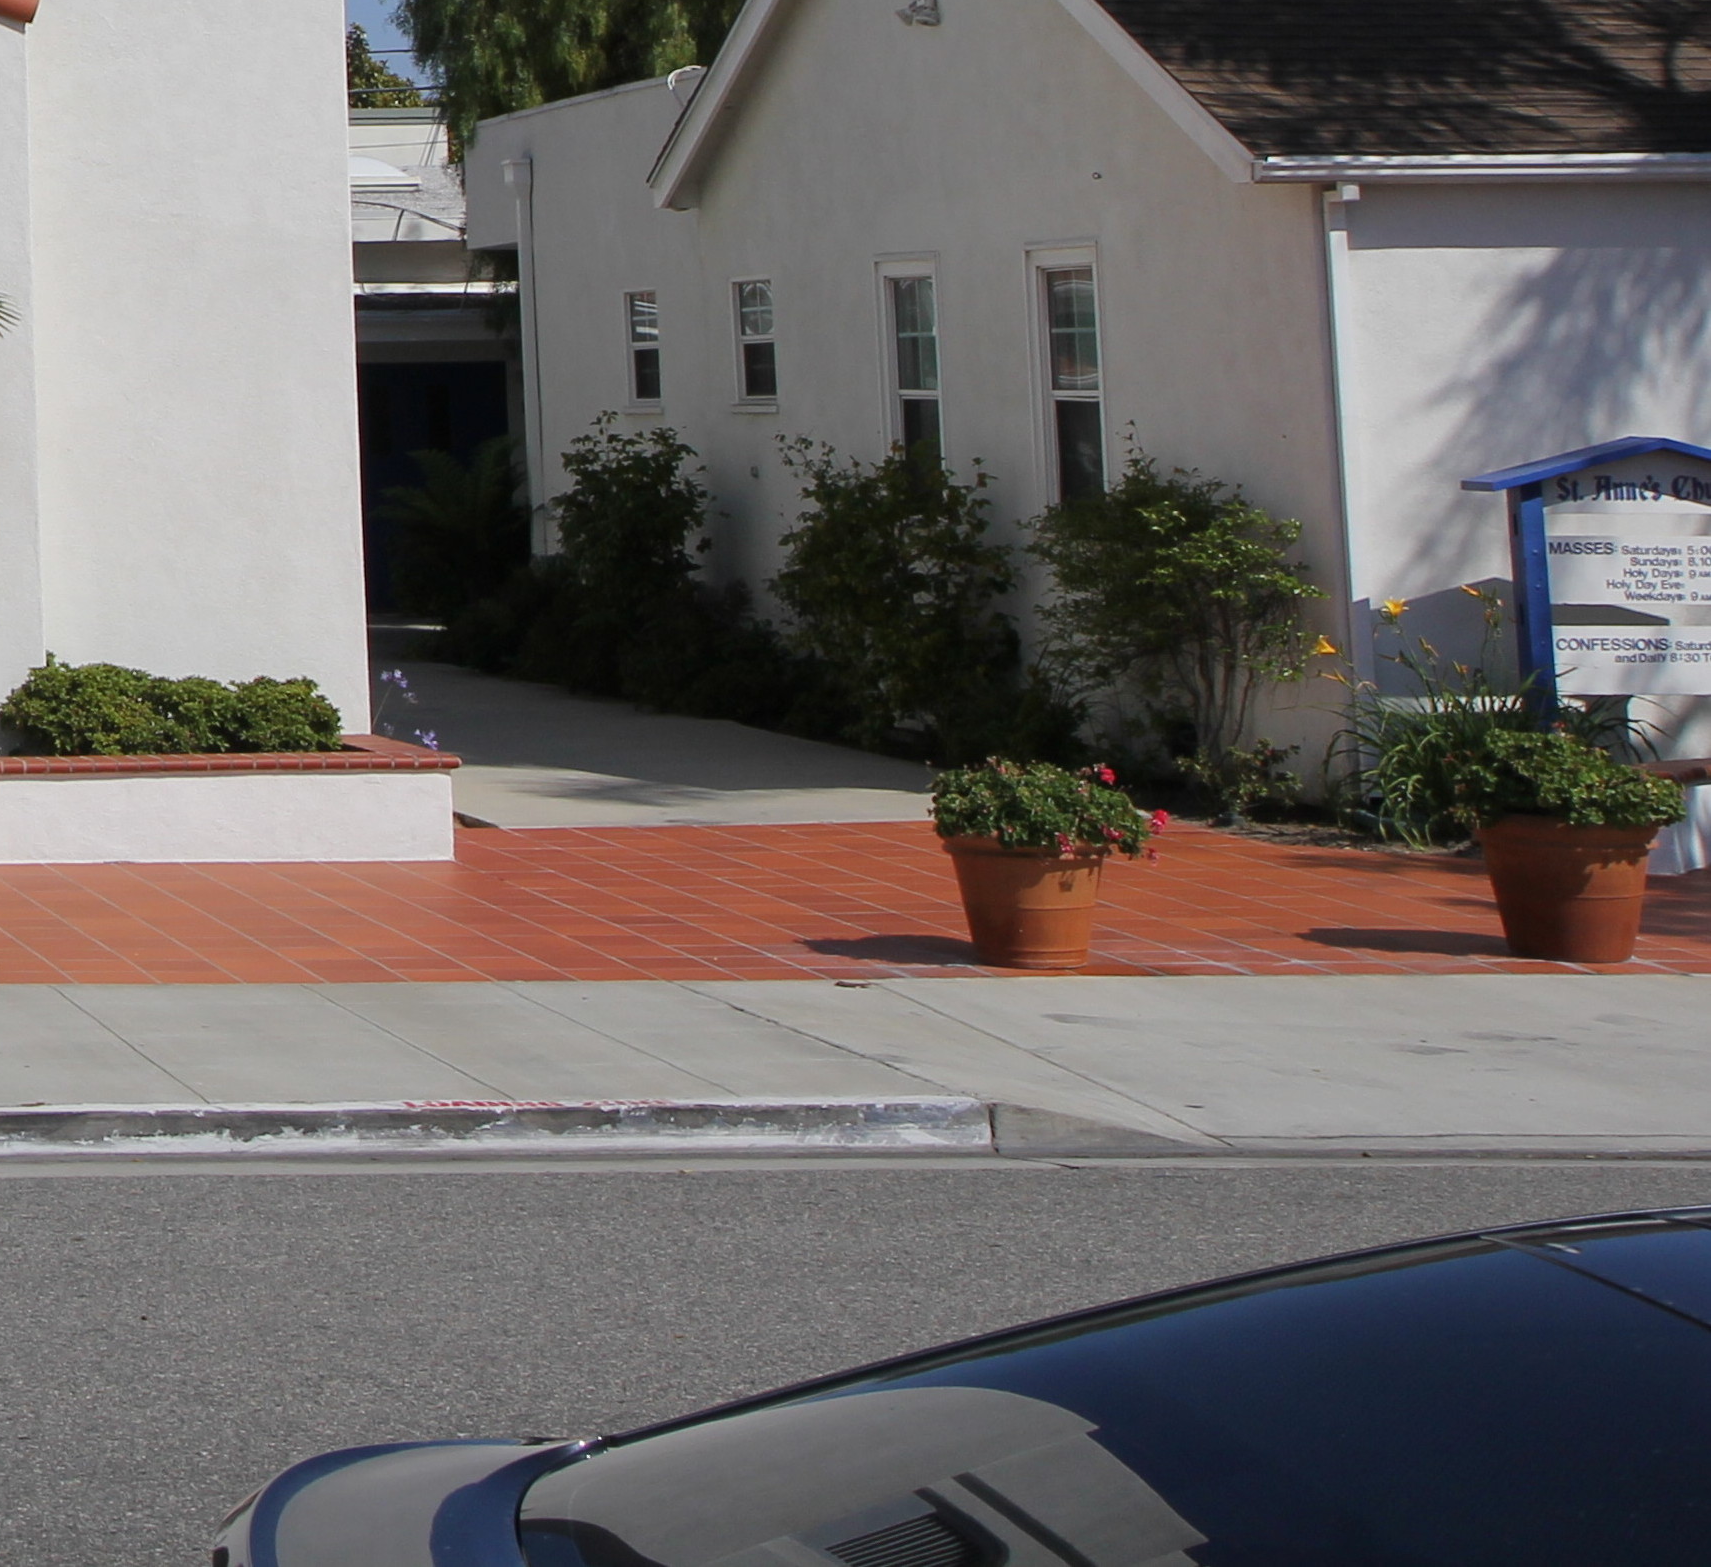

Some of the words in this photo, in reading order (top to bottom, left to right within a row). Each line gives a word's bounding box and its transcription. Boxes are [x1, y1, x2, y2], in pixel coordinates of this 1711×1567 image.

[1556, 477, 1583, 502] St.
[1591, 475, 1661, 502] Anne's
[1549, 542, 1617, 555] MASSES:
[1621, 546, 1682, 557] Saturdays:
[1630, 557, 1682, 568] Sundays:
[1623, 568, 1647, 580] Holy
[1606, 579, 1631, 591] Holy
[1635, 580, 1657, 591] Day
[1556, 638, 1672, 651] CONFESSIONS:
[1615, 653, 1636, 663] and
[1670, 653, 1700, 663] 8:30
